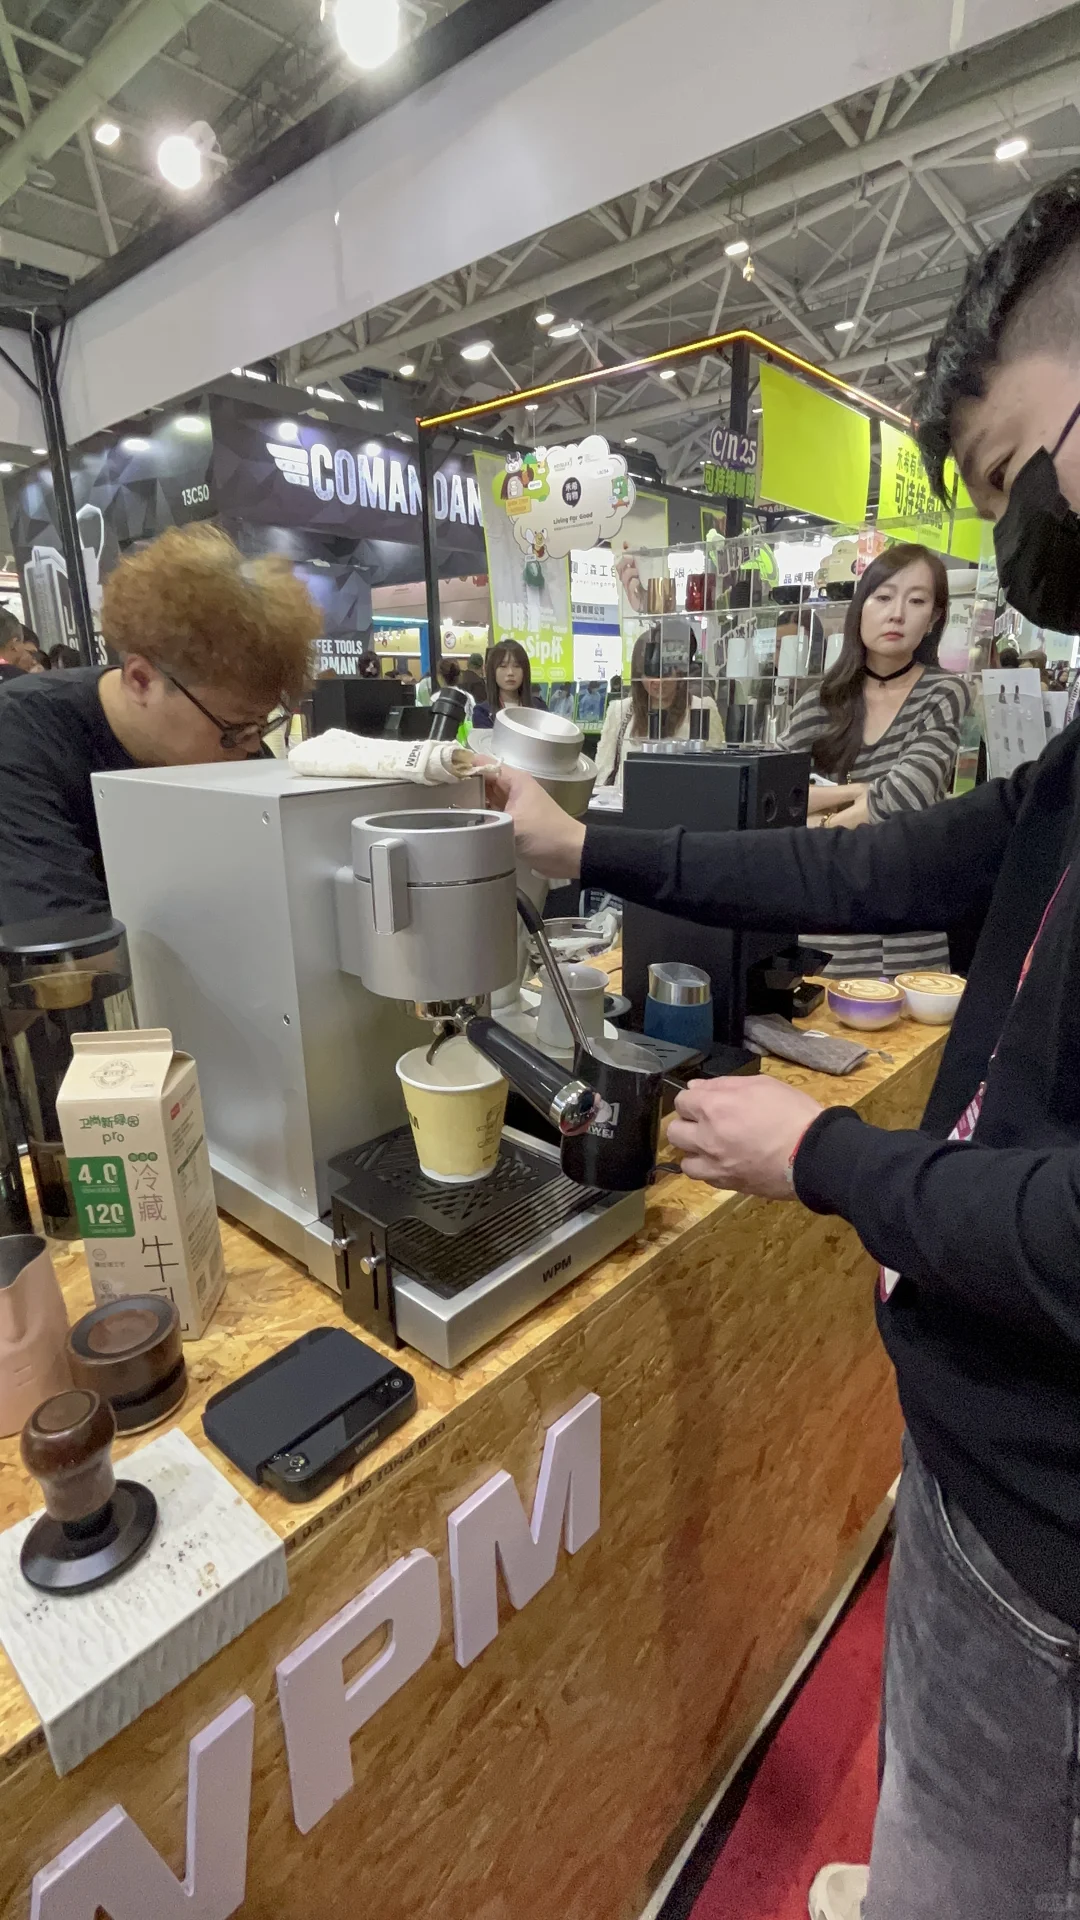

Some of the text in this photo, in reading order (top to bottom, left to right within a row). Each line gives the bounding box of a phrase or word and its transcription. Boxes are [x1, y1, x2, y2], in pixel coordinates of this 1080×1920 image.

[740, 438, 757, 466] 25
[181, 484, 210, 506] 13C50
[553, 517, 569, 525] Living
[579, 512, 593, 520] Good
[334, 640, 363, 655] TOOLS
[501, 632, 563, 665] Sip杯
[405, 744, 422, 768] WPM
[102, 1131, 125, 1145] pro
[78, 1163, 117, 1184] 4.0
[85, 1203, 124, 1224] 120
[131, 1163, 189, 1331] 冷藏牛
[542, 1254, 572, 1283] WPM
